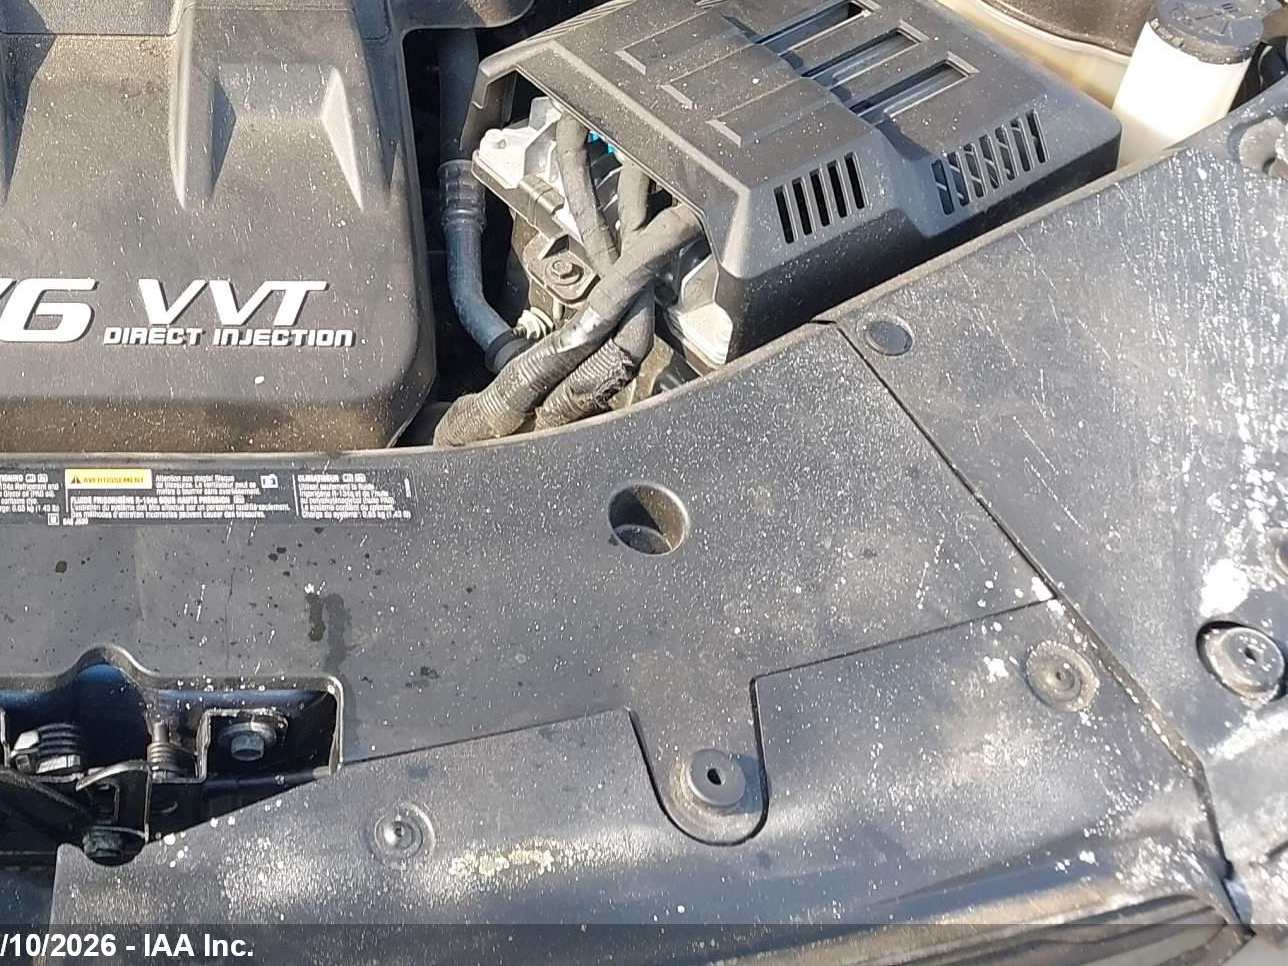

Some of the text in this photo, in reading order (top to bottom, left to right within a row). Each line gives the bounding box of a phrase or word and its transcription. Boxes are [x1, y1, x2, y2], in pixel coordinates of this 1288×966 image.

[137, 279, 329, 326] VVT
[103, 326, 354, 347] DIRECT INJECTION
